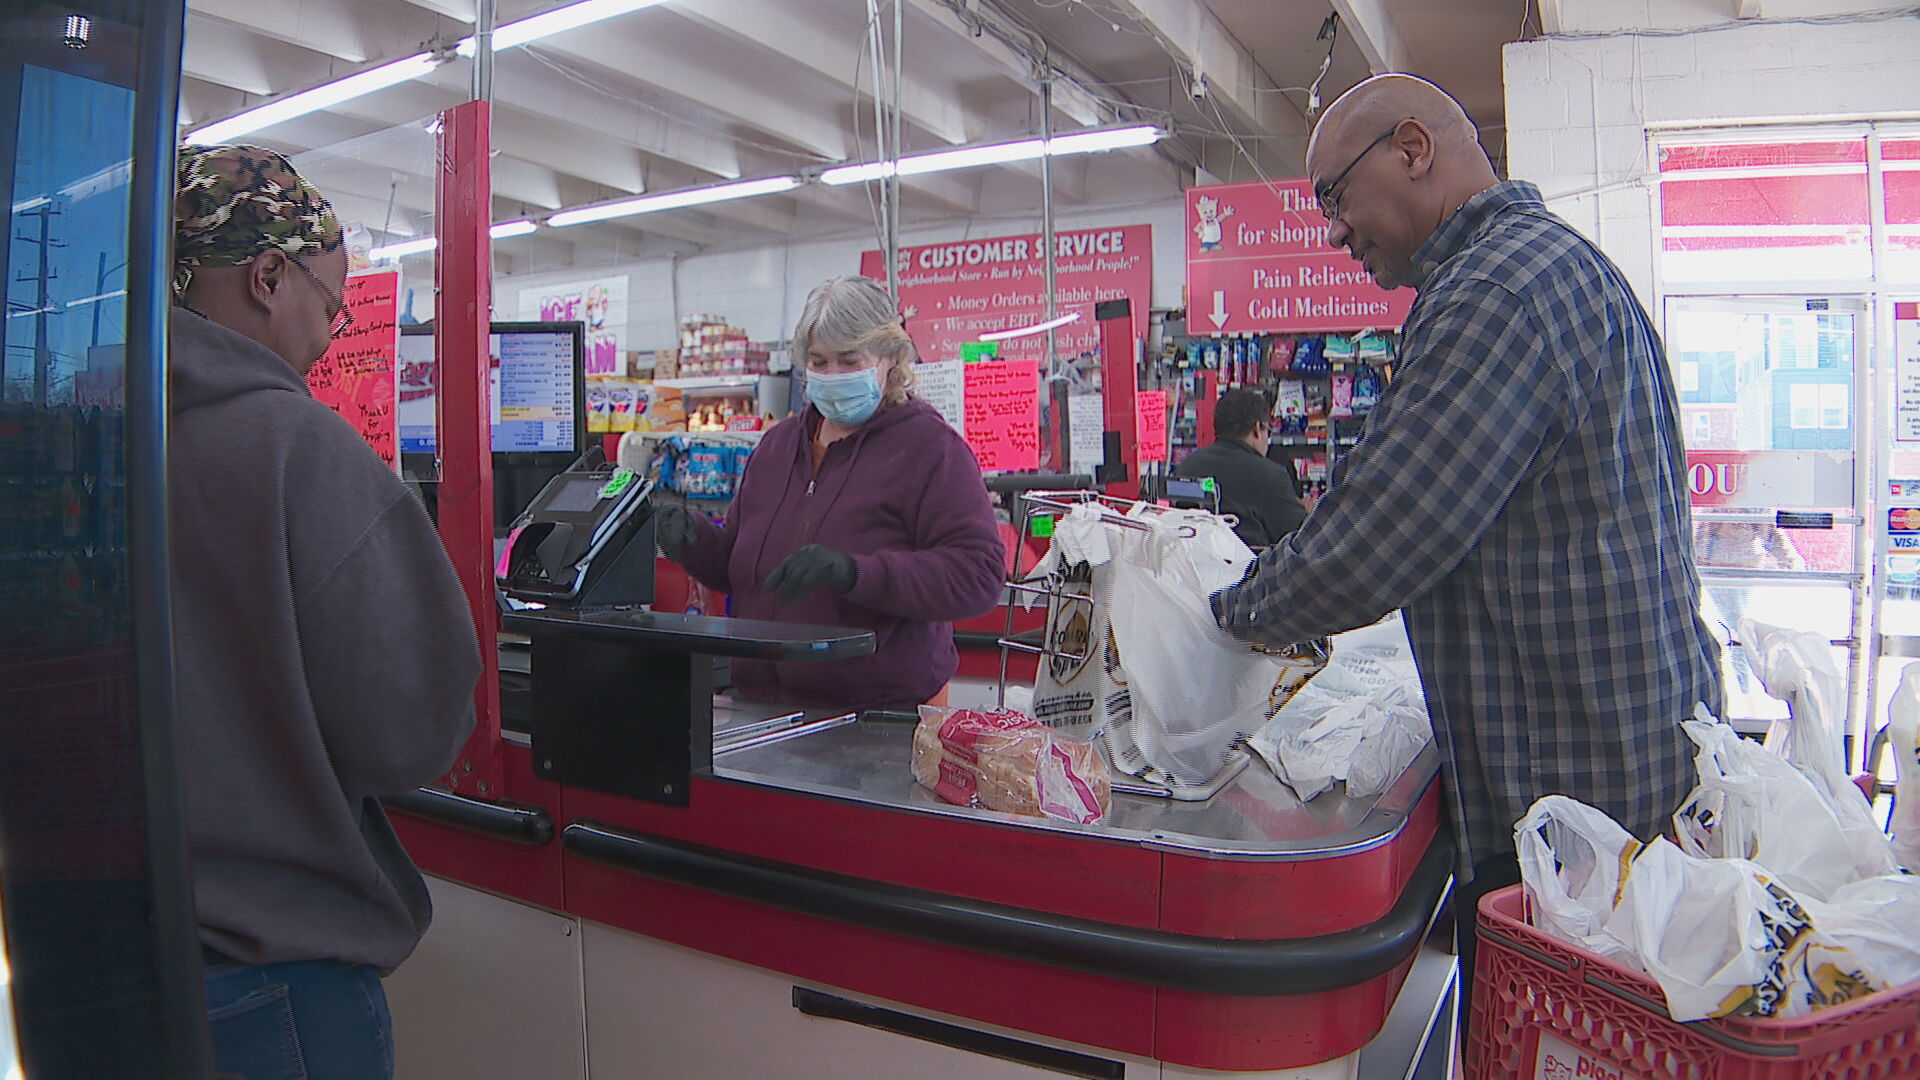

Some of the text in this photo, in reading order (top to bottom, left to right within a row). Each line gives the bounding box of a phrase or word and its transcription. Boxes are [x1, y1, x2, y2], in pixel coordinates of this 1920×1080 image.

[1280, 189, 1323, 212] Tha
[1238, 220, 1329, 249] for shopp
[920, 240, 1028, 269] CUSTOMER
[1035, 231, 1124, 259] SRVICE
[958, 269, 982, 282] Store
[990, 265, 1011, 280] Run
[1012, 264, 1024, 280] by
[1253, 267, 1292, 289] Pain
[948, 296, 989, 311] Money
[991, 289, 1036, 309] Orders
[1248, 296, 1389, 319] Cold Medicines
[946, 316, 965, 331] We
[967, 316, 1006, 332] accept
[1009, 312, 1038, 329] EBT
[1003, 338, 1020, 350] do
[1022, 337, 1042, 349] not
